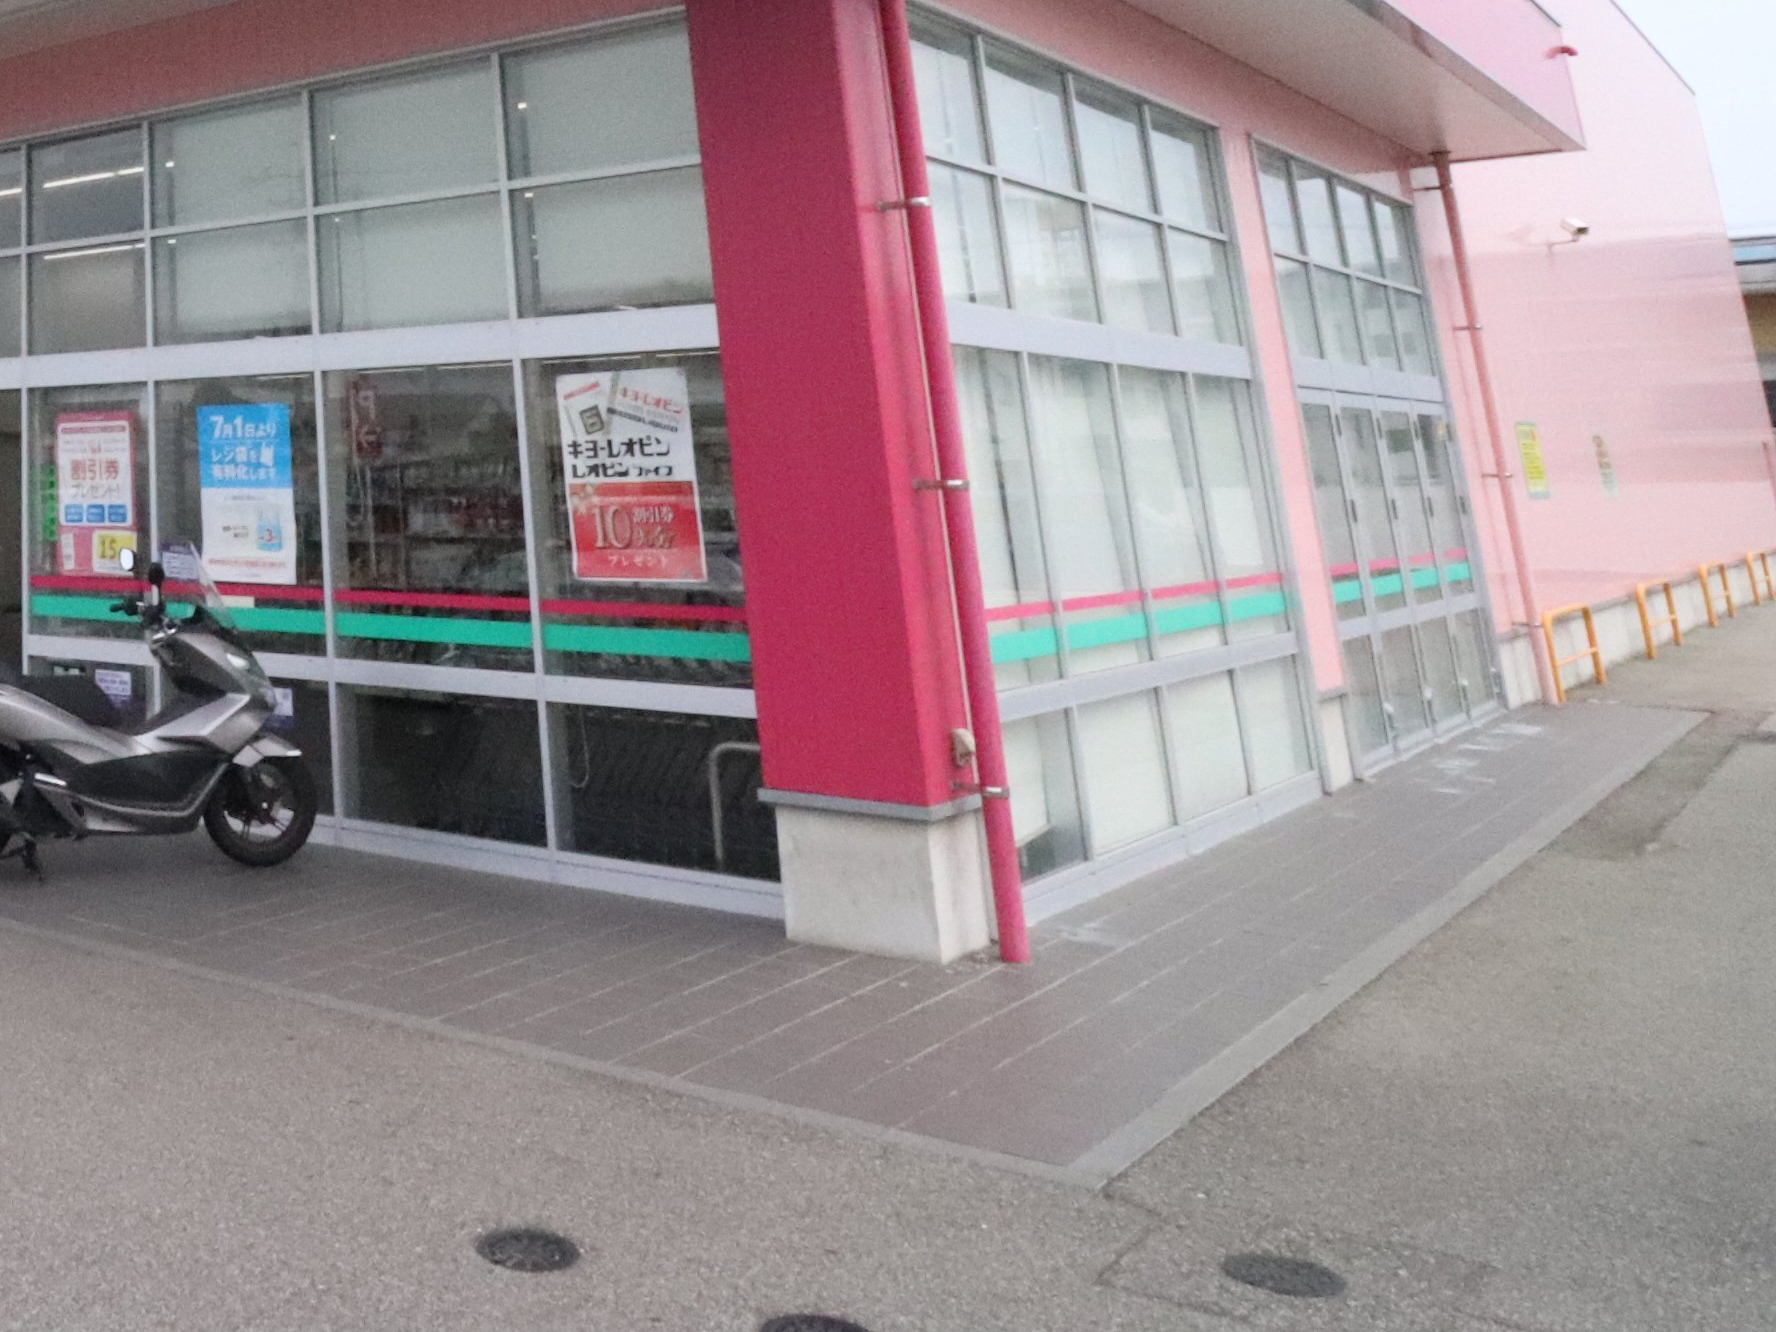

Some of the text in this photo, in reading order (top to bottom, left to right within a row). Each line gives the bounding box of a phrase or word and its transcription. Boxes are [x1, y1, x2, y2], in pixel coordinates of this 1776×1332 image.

[209, 415, 277, 440] 7月1日より
[71, 458, 119, 481] 割引券
[594, 505, 632, 549] 10
